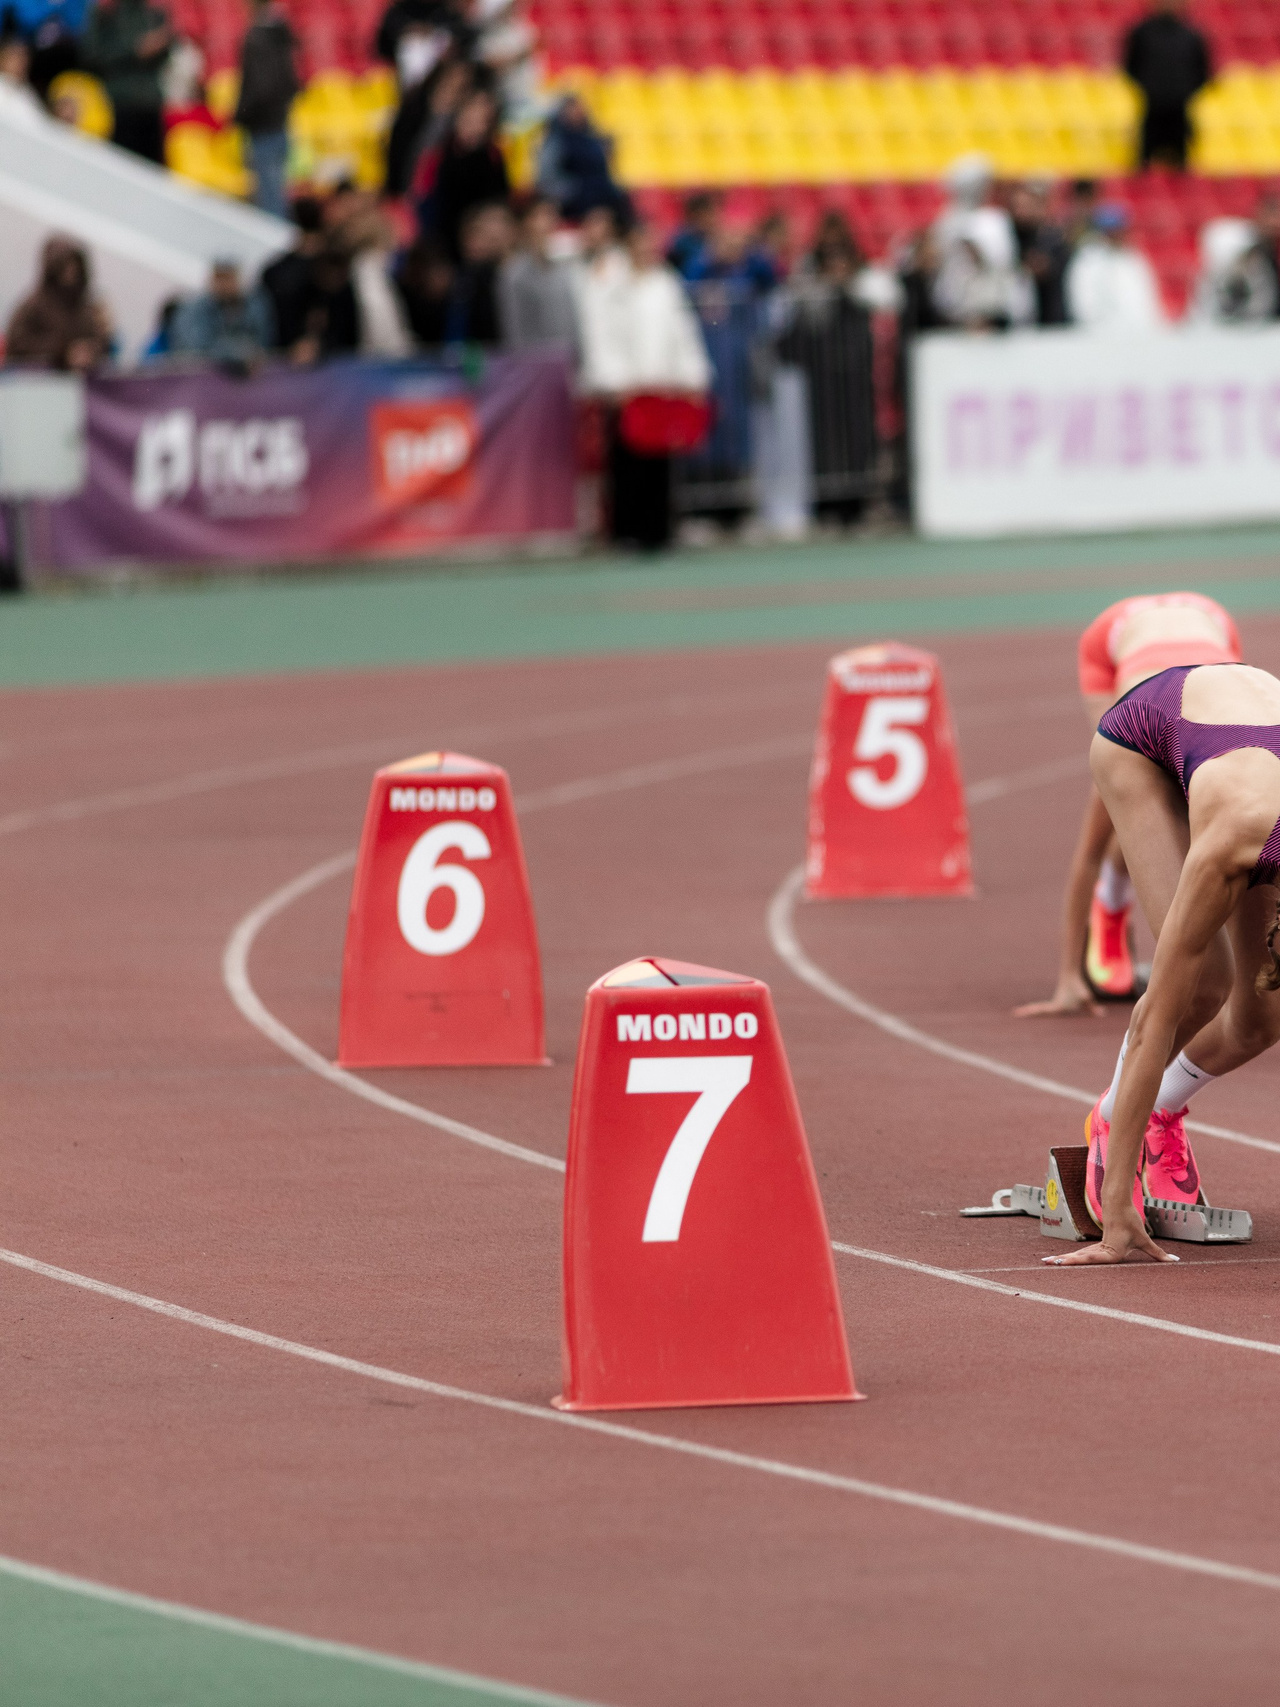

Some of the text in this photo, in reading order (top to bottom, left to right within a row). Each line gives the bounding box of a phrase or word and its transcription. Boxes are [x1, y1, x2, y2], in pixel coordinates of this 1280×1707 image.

[390, 787, 496, 812] MONDO
[847, 696, 930, 811] 5
[397, 820, 492, 956] 6
[617, 1012, 759, 1041] MONDO
[625, 1055, 753, 1243] 7
